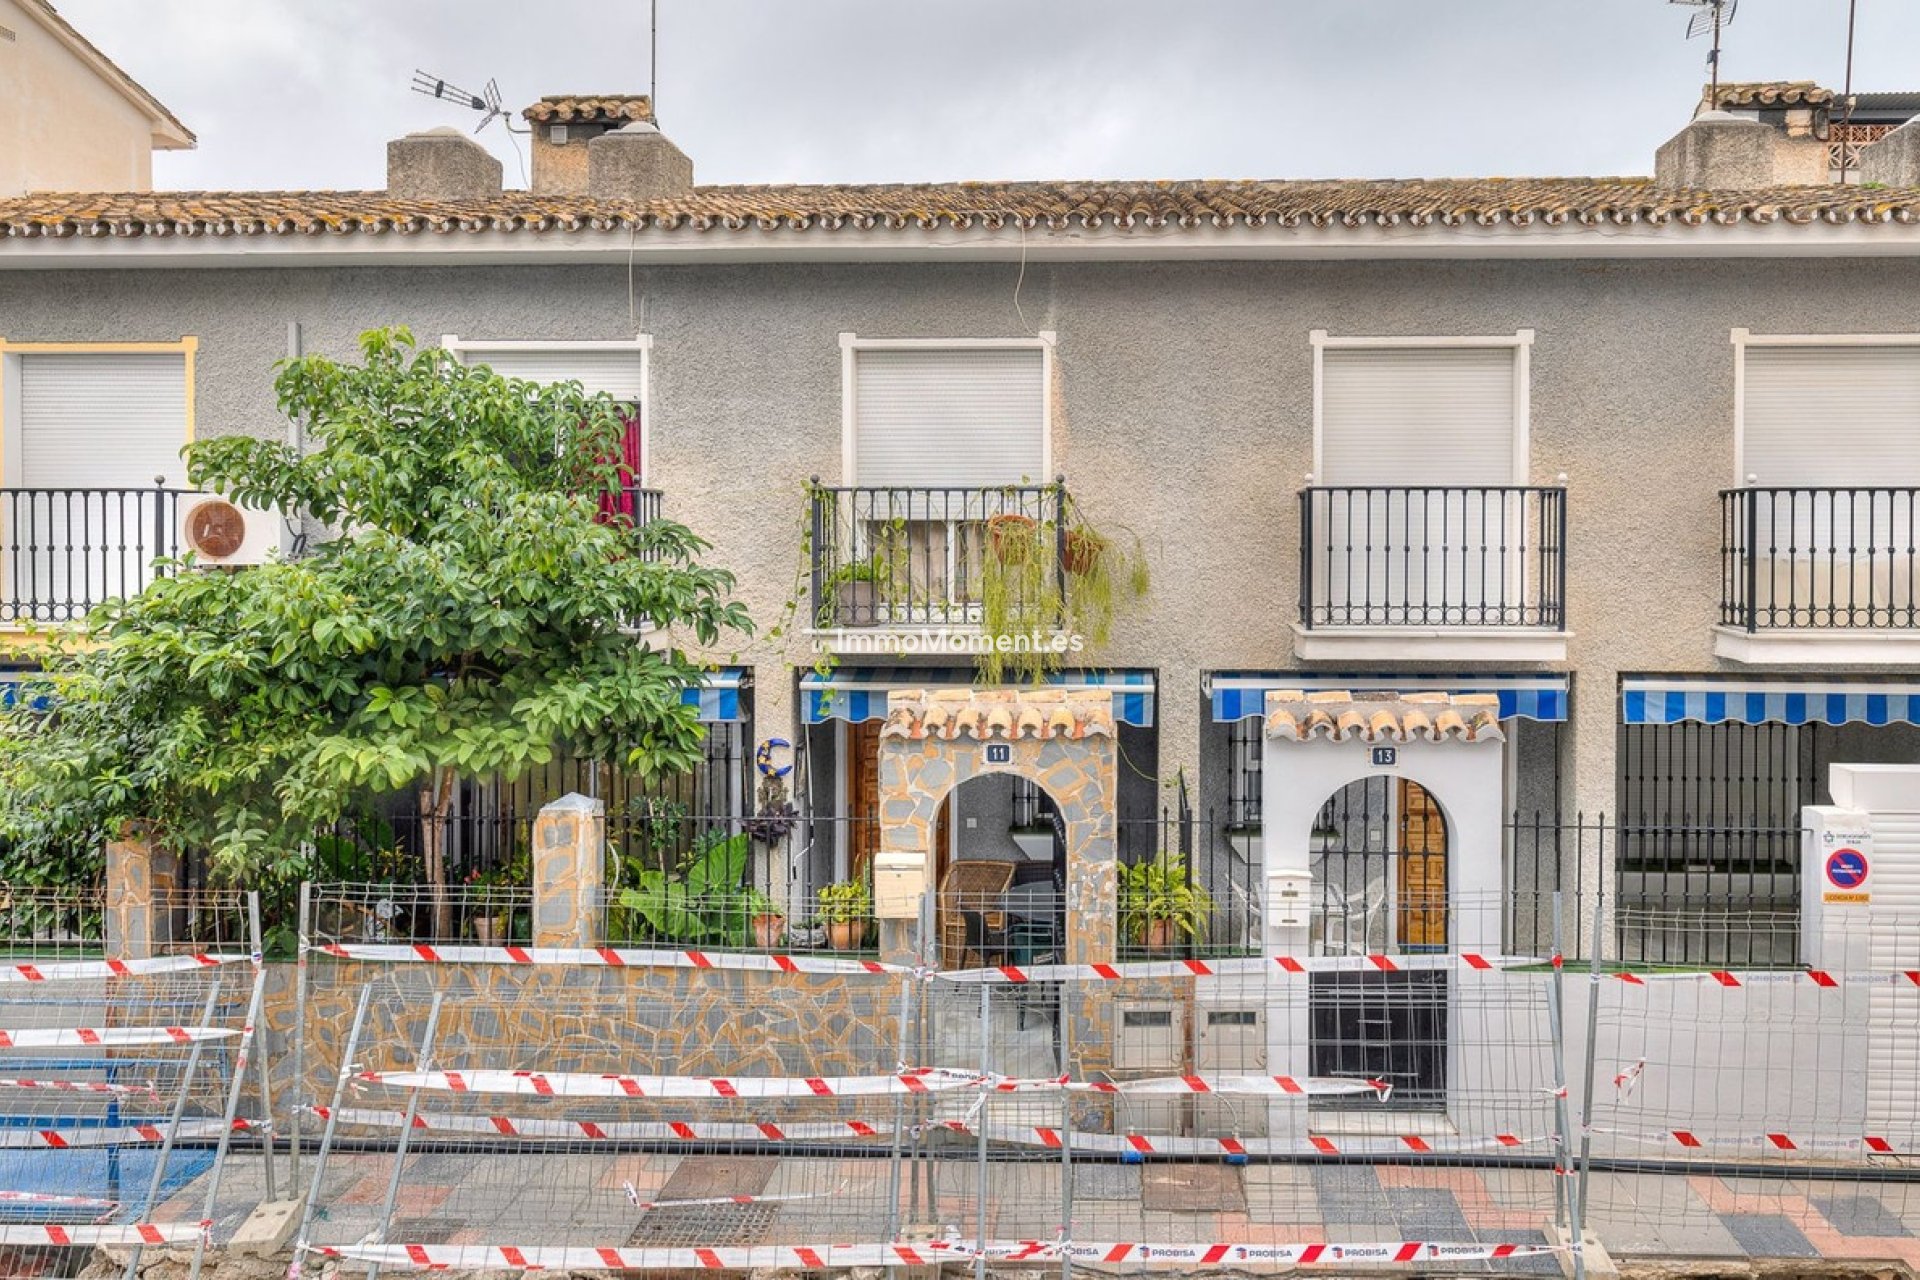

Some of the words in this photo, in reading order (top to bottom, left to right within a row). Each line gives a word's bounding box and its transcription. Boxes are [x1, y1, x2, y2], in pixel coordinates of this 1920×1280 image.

[992, 747, 1005, 760] 11
[1378, 749, 1393, 763] 13
[1152, 1248, 1196, 1258] PROBISA
[1249, 1249, 1293, 1259] PROBISA
[1344, 1247, 1389, 1257] PROBISA
[1440, 1245, 1486, 1255] PROBISA
